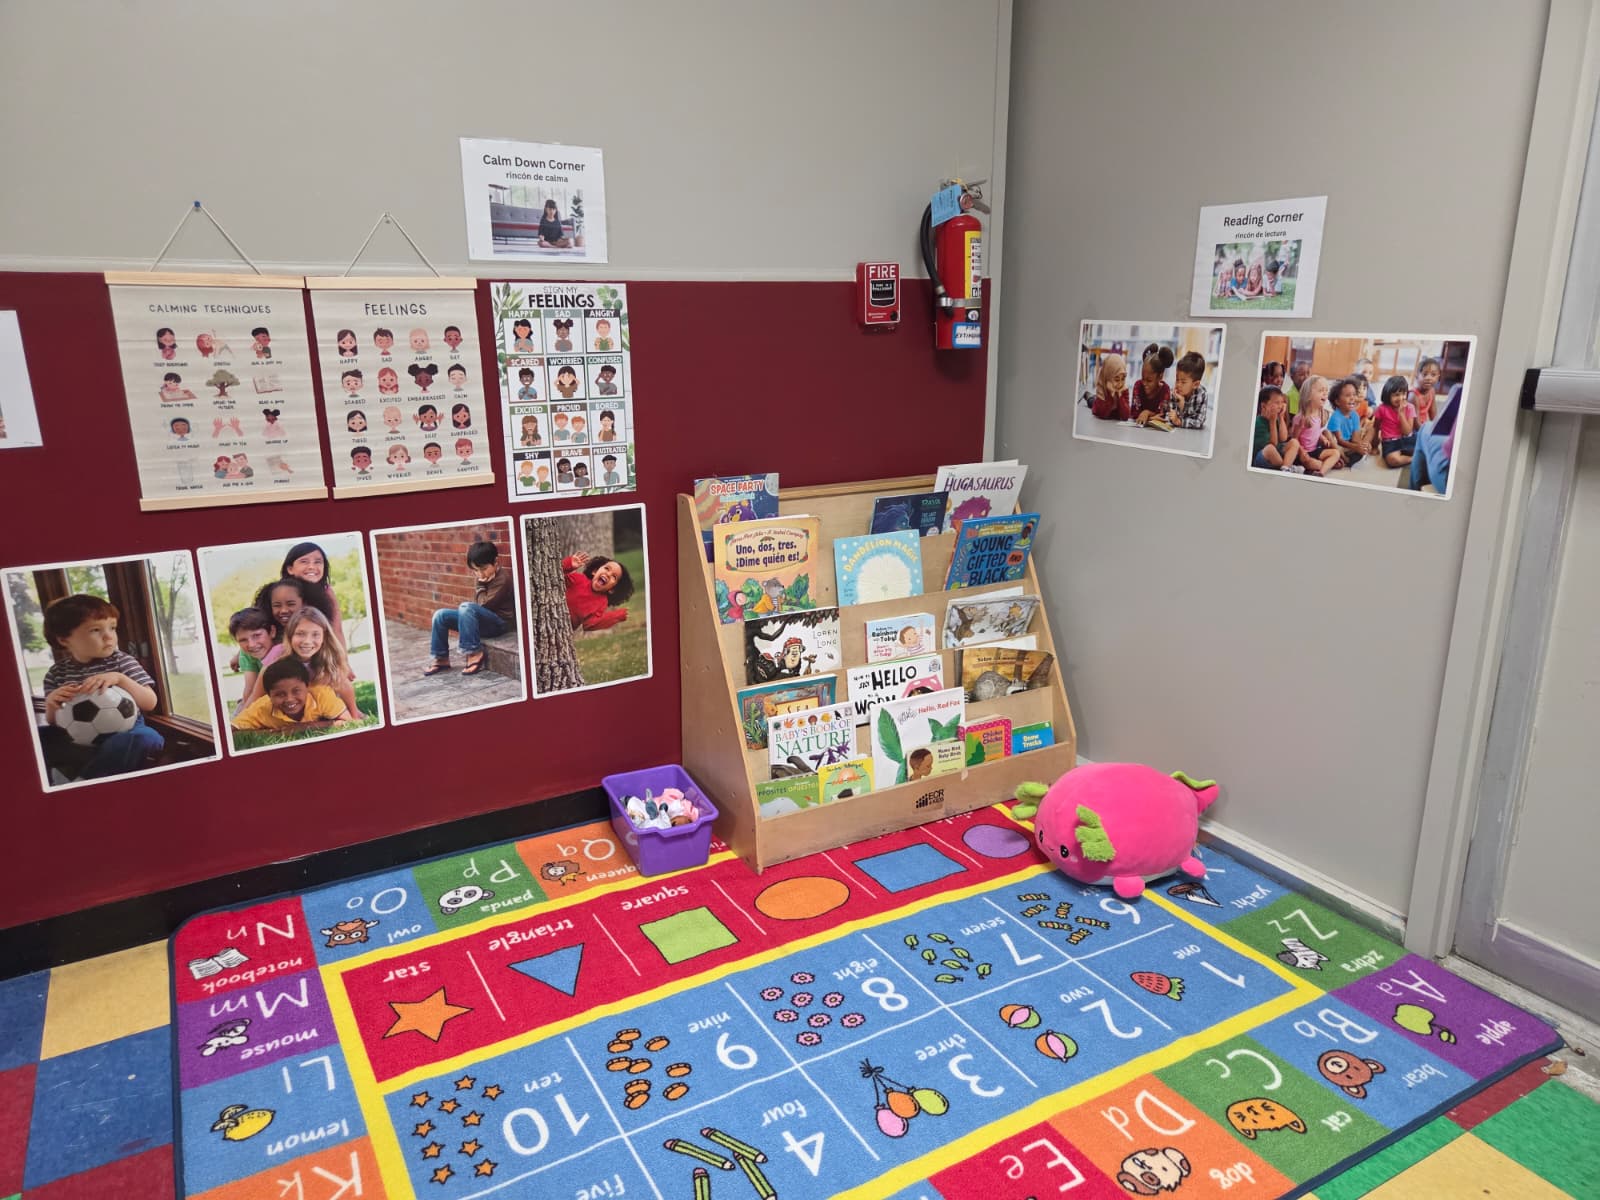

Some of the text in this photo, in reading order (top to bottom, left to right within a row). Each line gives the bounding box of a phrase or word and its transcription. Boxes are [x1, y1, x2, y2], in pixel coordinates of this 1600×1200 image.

[483, 154, 586, 172] Calm Down Corner
[506, 172, 568, 183] rincón de calma
[1223, 212, 1304, 227] Reading Corner
[1265, 230, 1286, 238] lectura
[869, 265, 896, 278] FIRE
[528, 294, 595, 308] FEELINGS
[543, 286, 563, 294] SIGN
[149, 304, 271, 314] CALMING TECHNIQUES
[365, 303, 427, 316] FEELINGS
[508, 310, 534, 318] HAPPY
[589, 309, 615, 317] ANGRY
[550, 357, 582, 365] WORRIED
[588, 356, 622, 364] CONFUSED
[514, 406, 543, 414] EXCITED
[557, 404, 580, 412] PROUD
[525, 452, 539, 460] SHY
[561, 449, 583, 457] BRAVE
[593, 446, 627, 454] FRUSTRATED
[710, 479, 764, 496] SPACE PARTY
[944, 476, 1016, 492] HUGASAURUS
[736, 545, 755, 554] Uno,
[758, 543, 775, 552] dos,
[843, 539, 892, 572] DANDELION
[969, 536, 1013, 554] YOUNG
[736, 552, 799, 568] ¡Dime quién es!
[967, 567, 1009, 587] BLACK
[813, 629, 838, 639] LOREN
[817, 640, 837, 648] LONG
[871, 666, 917, 691] HELLO
[776, 719, 850, 742] BABY'S BOOK OF
[776, 728, 851, 759] NATURE
[480, 889, 534, 914] panda
[620, 885, 689, 911] square
[1231, 884, 1272, 909] yacht
[1099, 896, 1141, 925] 6
[387, 924, 422, 944] owl
[488, 919, 574, 952] triangle
[960, 916, 1006, 936] seven
[1001, 932, 1043, 966] 7
[1172, 943, 1201, 960] one
[382, 961, 431, 983] star
[832, 958, 878, 981] eight
[1340, 950, 1385, 973] zebra
[202, 957, 303, 994] notebook
[1200, 960, 1246, 989] 1
[860, 976, 909, 1012] 8
[1059, 985, 1095, 1005] two
[688, 1011, 732, 1033] nine
[1079, 998, 1143, 1039] 2
[1475, 1018, 1517, 1047] apple
[240, 1028, 319, 1060] mouse
[716, 1032, 758, 1070] 9
[914, 1032, 968, 1062] three
[524, 1071, 563, 1093] ten
[948, 1052, 1005, 1098] 3
[1401, 1063, 1448, 1089] bear
[761, 1099, 808, 1127] four
[1320, 1110, 1352, 1133] cat
[502, 1093, 590, 1156] 10
[266, 1118, 350, 1156] lemon
[781, 1130, 825, 1177] 4
[575, 1173, 626, 1200] five
[1208, 1160, 1257, 1192] dog
